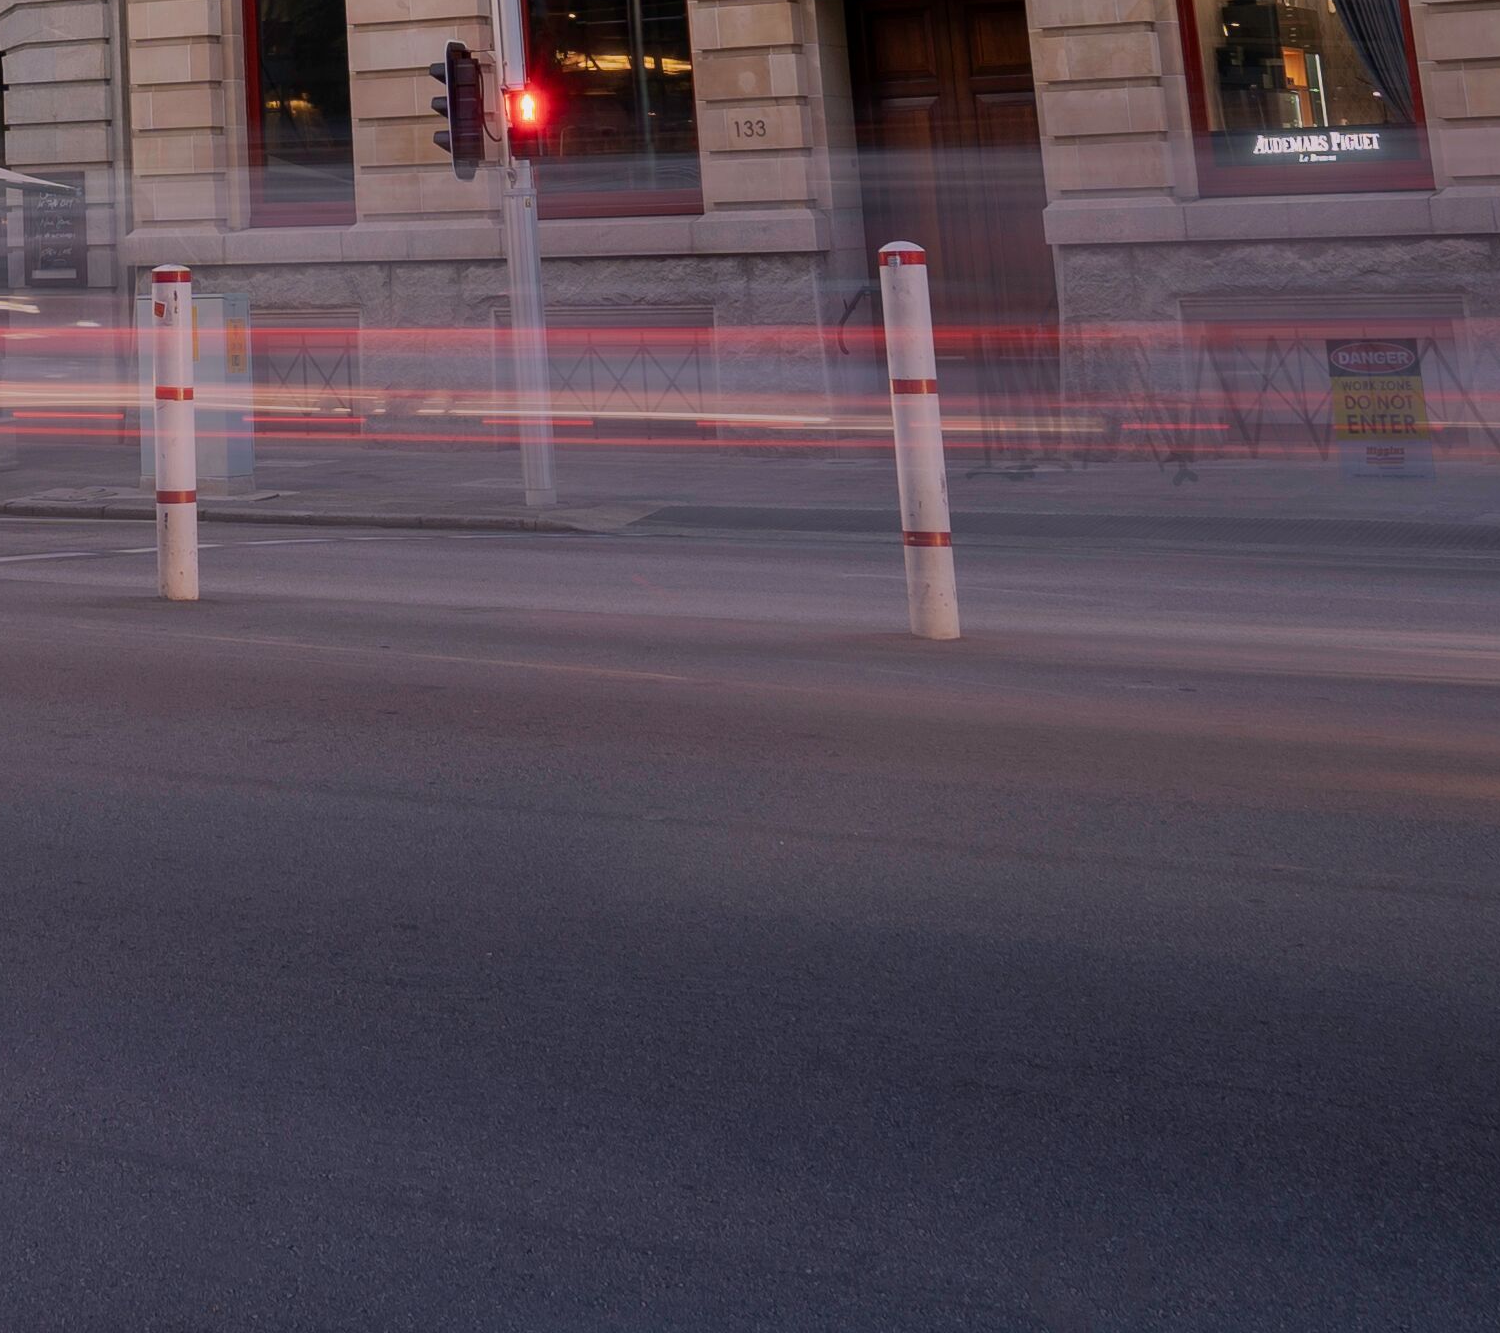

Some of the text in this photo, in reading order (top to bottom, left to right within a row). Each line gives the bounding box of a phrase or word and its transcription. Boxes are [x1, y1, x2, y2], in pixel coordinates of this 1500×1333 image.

[734, 120, 766, 138] 133
[1329, 132, 1380, 151] PIGUET
[1338, 351, 1410, 367] DANGER
[1343, 380, 1413, 391] WORK ZONE
[1345, 394, 1413, 410] DO NOT
[1347, 415, 1418, 434] ENTER
